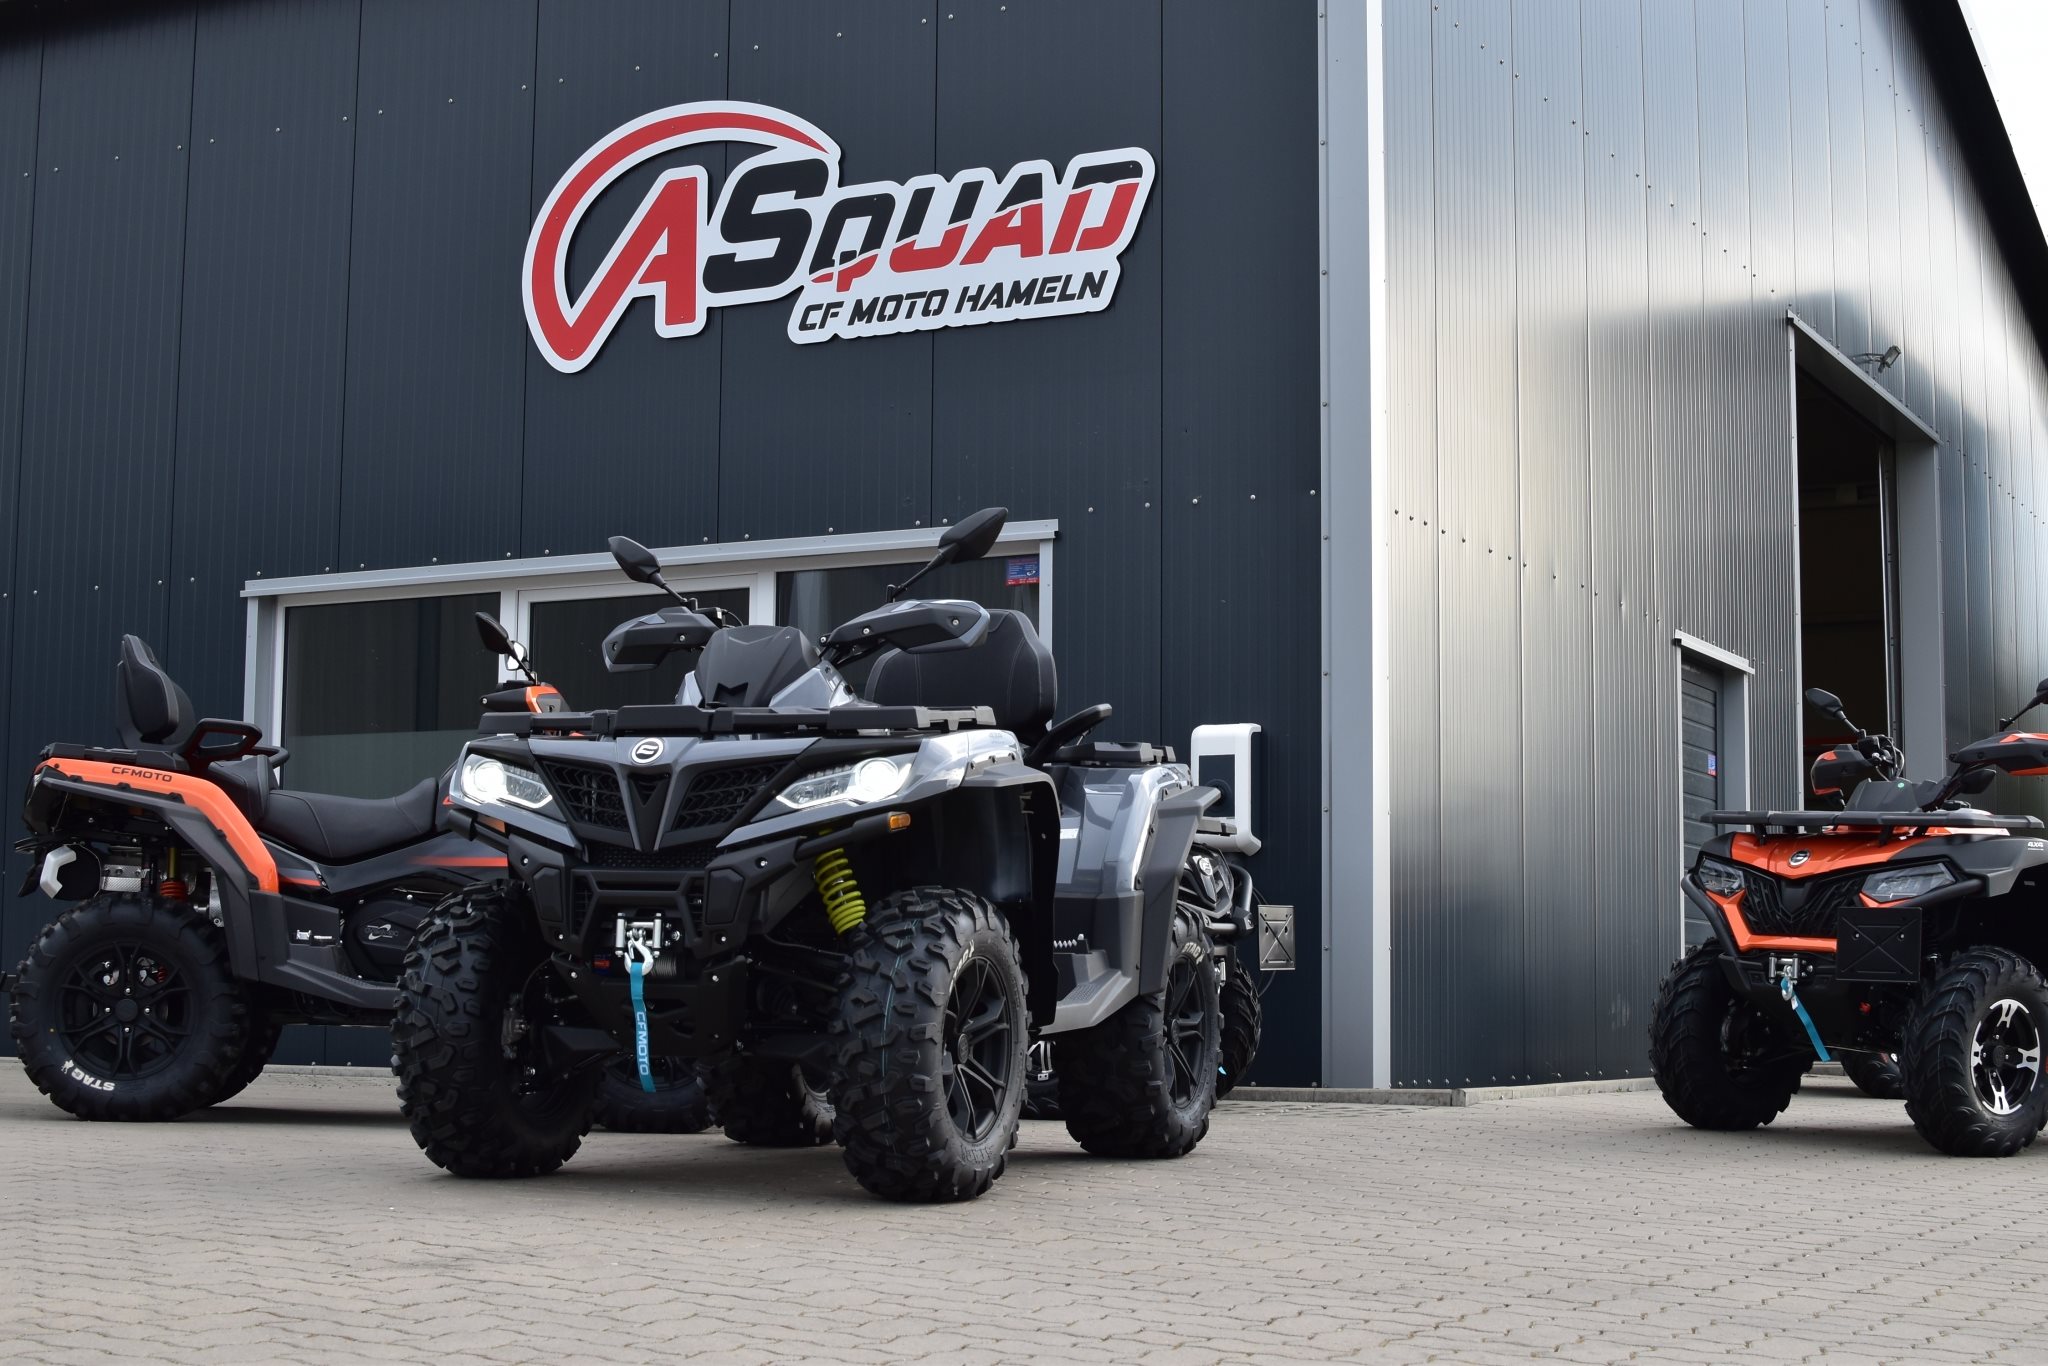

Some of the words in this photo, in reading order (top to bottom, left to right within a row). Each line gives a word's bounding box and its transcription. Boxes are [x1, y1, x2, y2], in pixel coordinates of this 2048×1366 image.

[798, 301, 844, 332] CF
[847, 289, 949, 326] MOTO
[954, 270, 1108, 314] HAMELN
[111, 766, 172, 782] CFMOTO
[636, 1011, 649, 1075] CFMOTO
